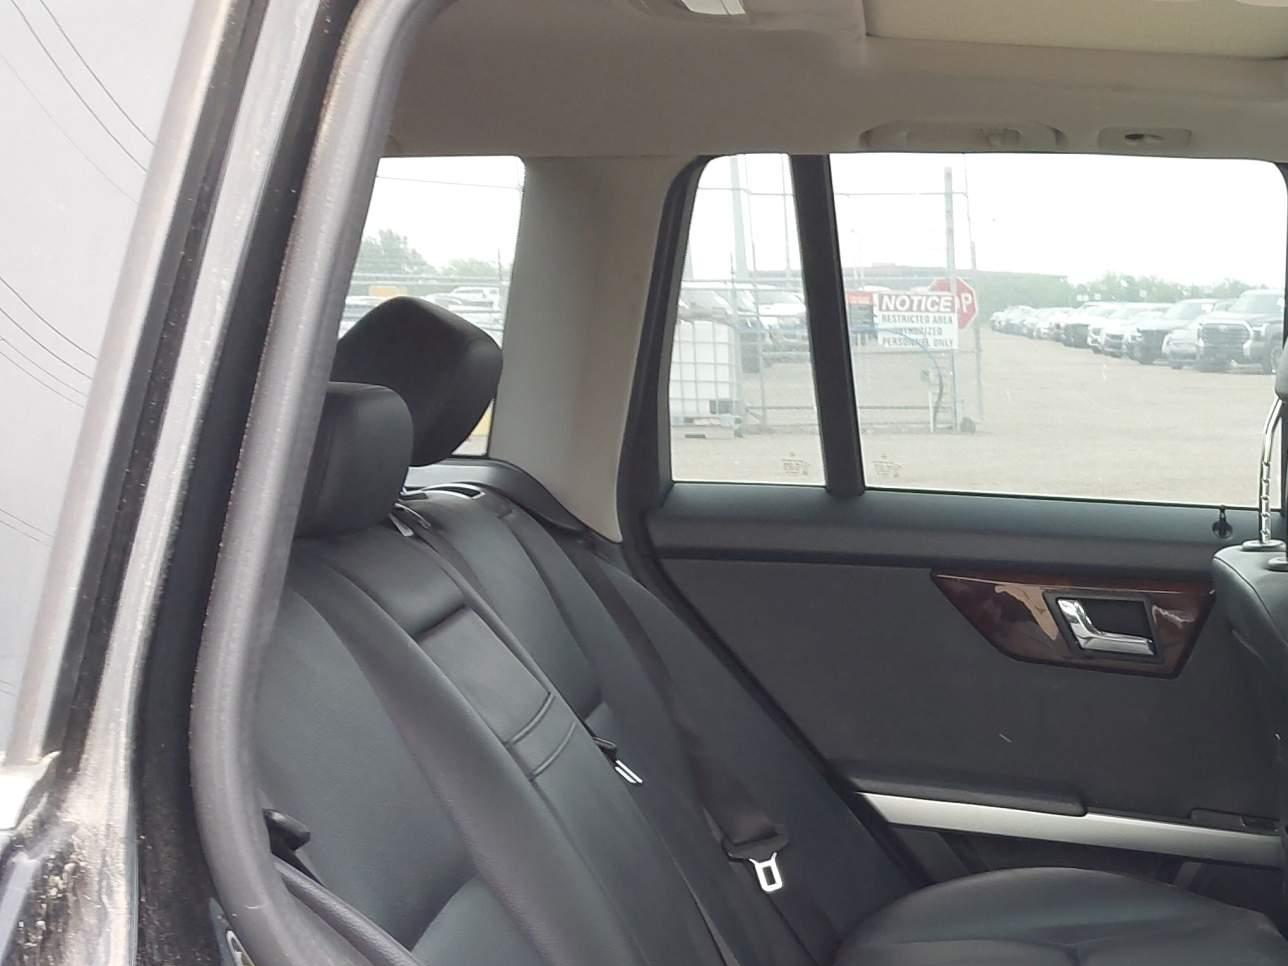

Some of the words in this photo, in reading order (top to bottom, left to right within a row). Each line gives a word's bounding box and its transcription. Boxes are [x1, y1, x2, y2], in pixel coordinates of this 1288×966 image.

[881, 295, 953, 312] NOTICE
[881, 314, 930, 323] RESTRICTED
[932, 315, 953, 324] AREA
[891, 326, 943, 336] THORIZED
[932, 337, 953, 347] ONLY
